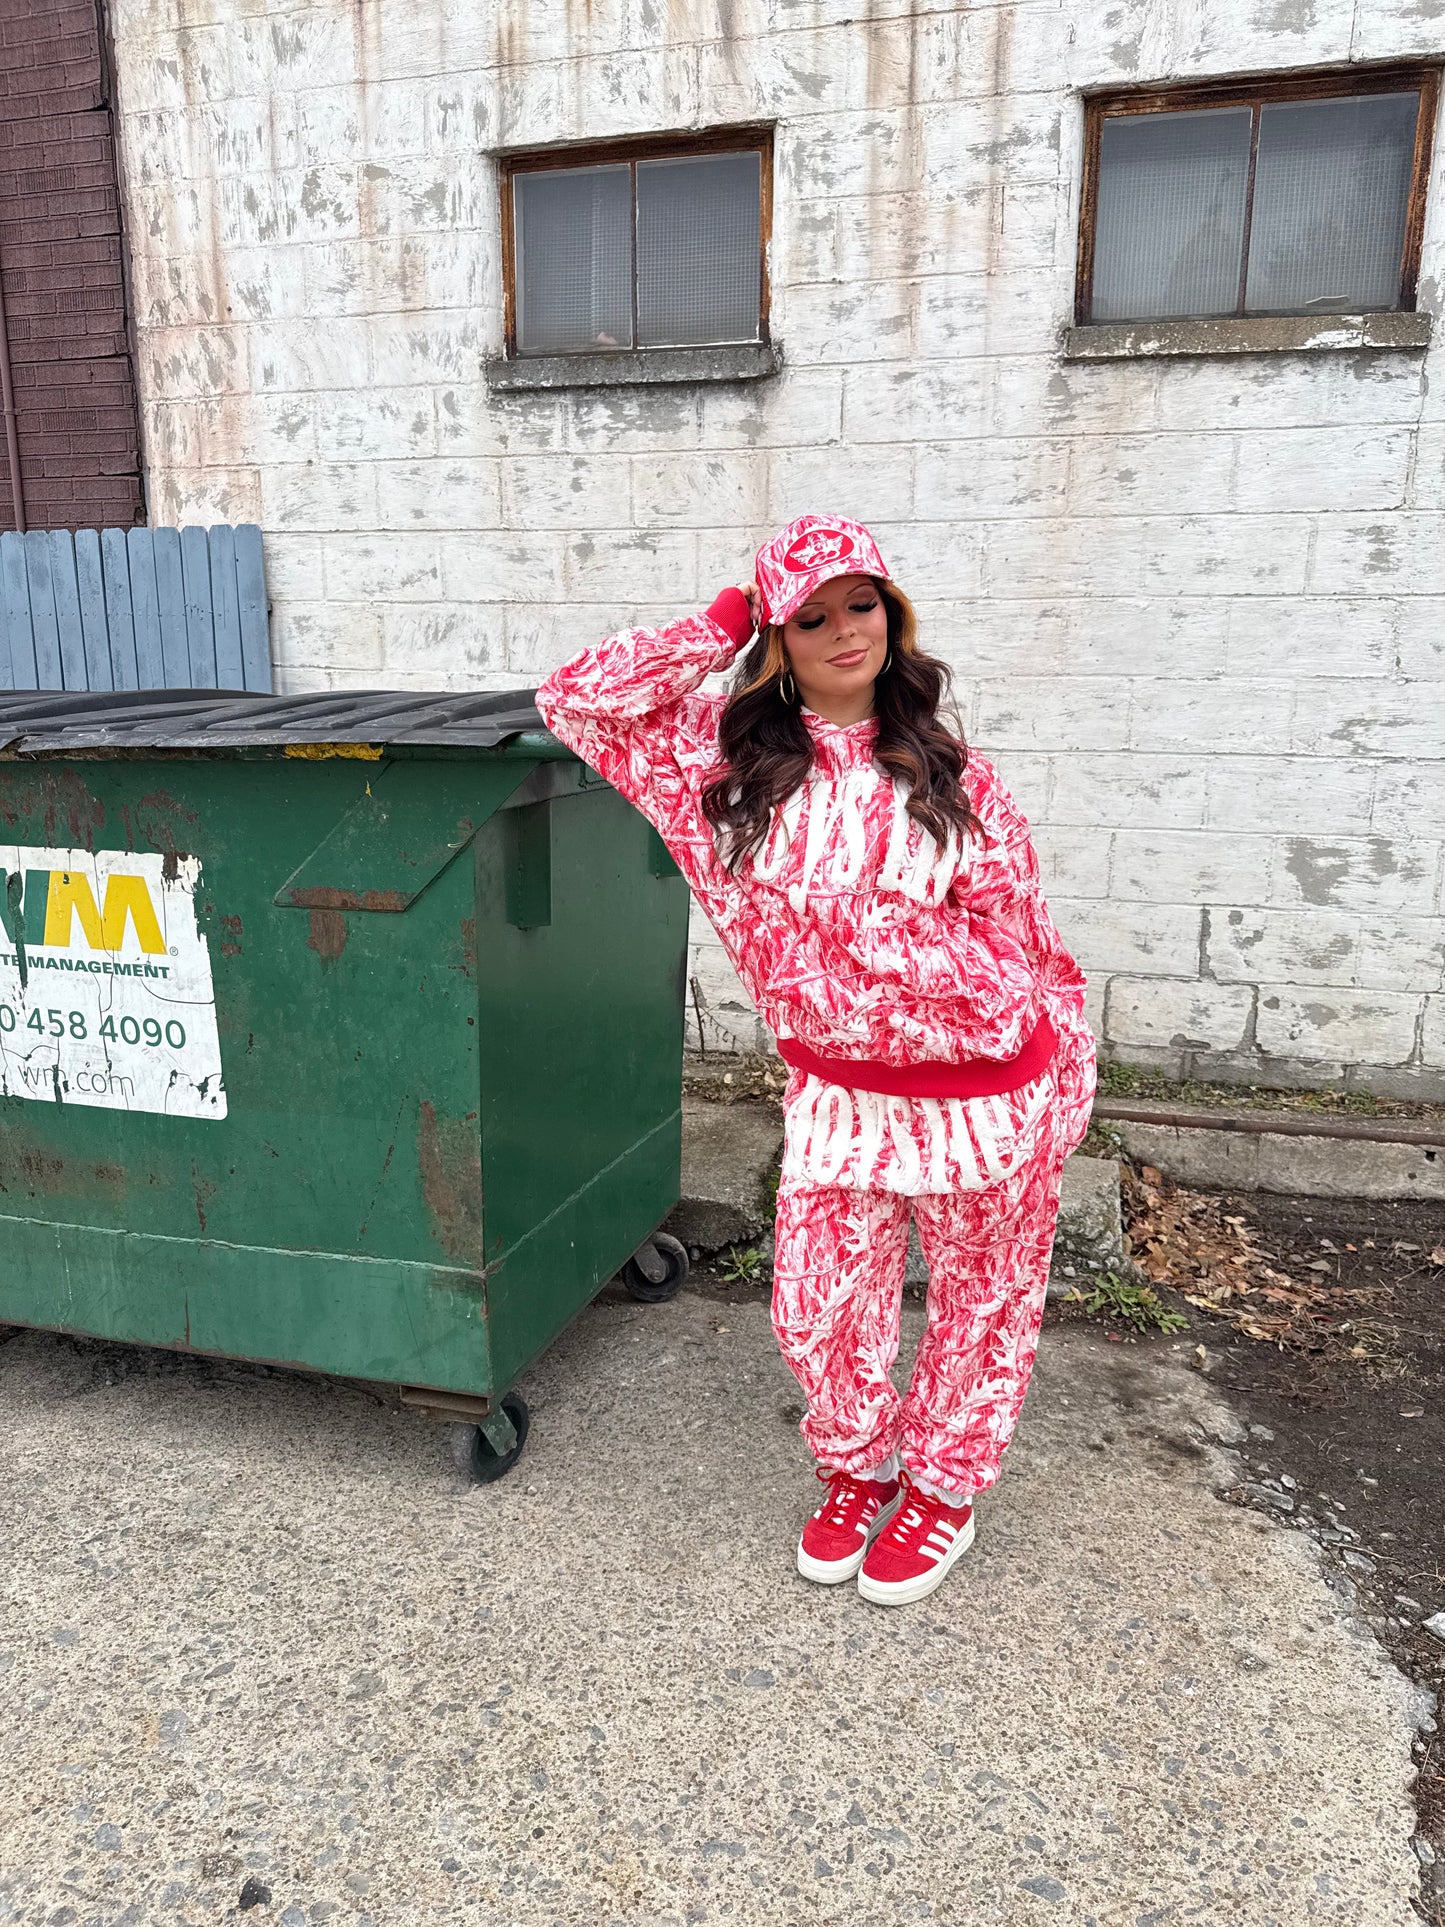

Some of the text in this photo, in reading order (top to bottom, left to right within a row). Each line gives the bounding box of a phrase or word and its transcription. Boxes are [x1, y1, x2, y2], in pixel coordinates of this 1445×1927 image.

[28, 956, 170, 979] MANAGEMENT
[27, 1007, 88, 1040] 458
[99, 1015, 187, 1049] 4090
[18, 1064, 135, 1096] wm.com
